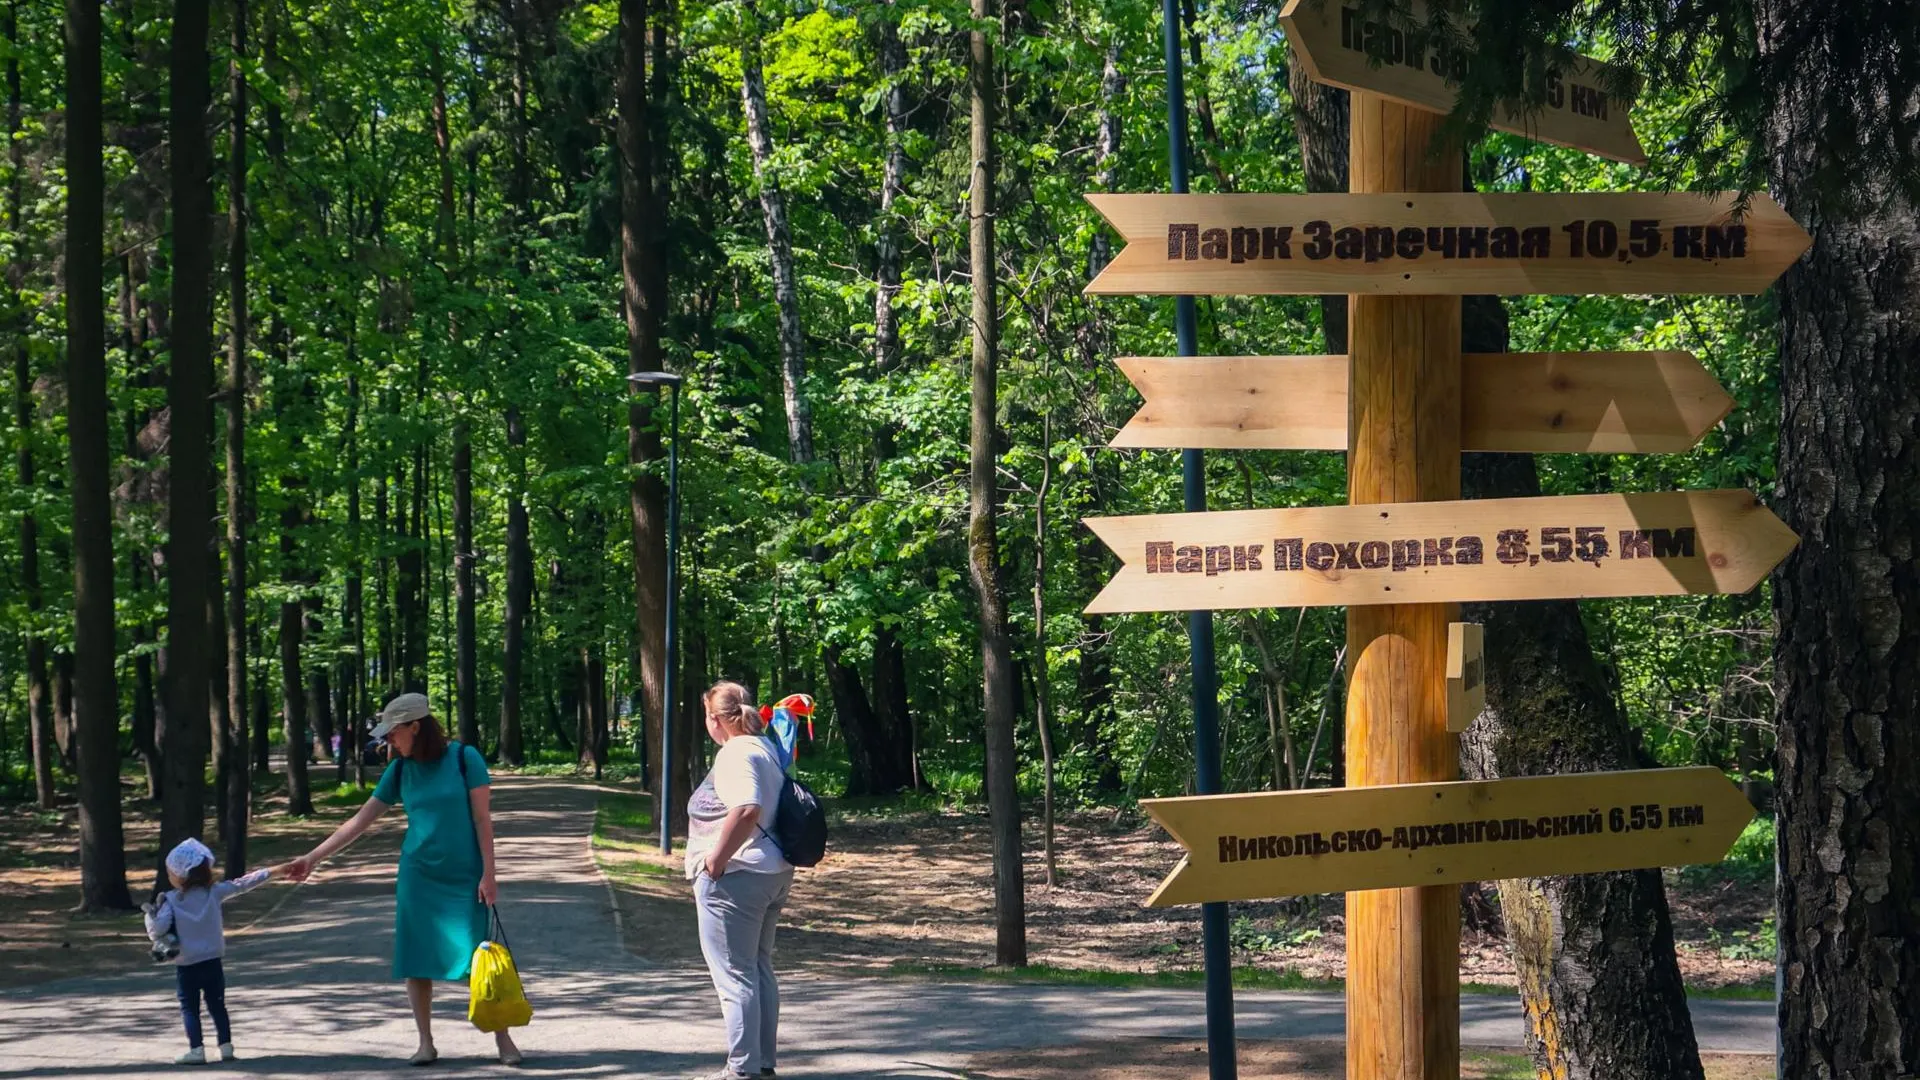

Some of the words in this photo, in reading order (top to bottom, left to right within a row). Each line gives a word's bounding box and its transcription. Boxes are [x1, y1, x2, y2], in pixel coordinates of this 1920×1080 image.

[1168, 221, 1294, 263] Парк
[1302, 220, 1550, 263] Заречная
[1562, 219, 1662, 262] 10,5
[1672, 224, 1747, 260] км
[1145, 541, 1264, 576] Парк
[1273, 535, 1483, 572] Пехорка
[1496, 527, 1610, 567] 8,55
[1619, 527, 1695, 560] км
[1609, 804, 1663, 833] 6,55
[1668, 804, 1704, 828] км
